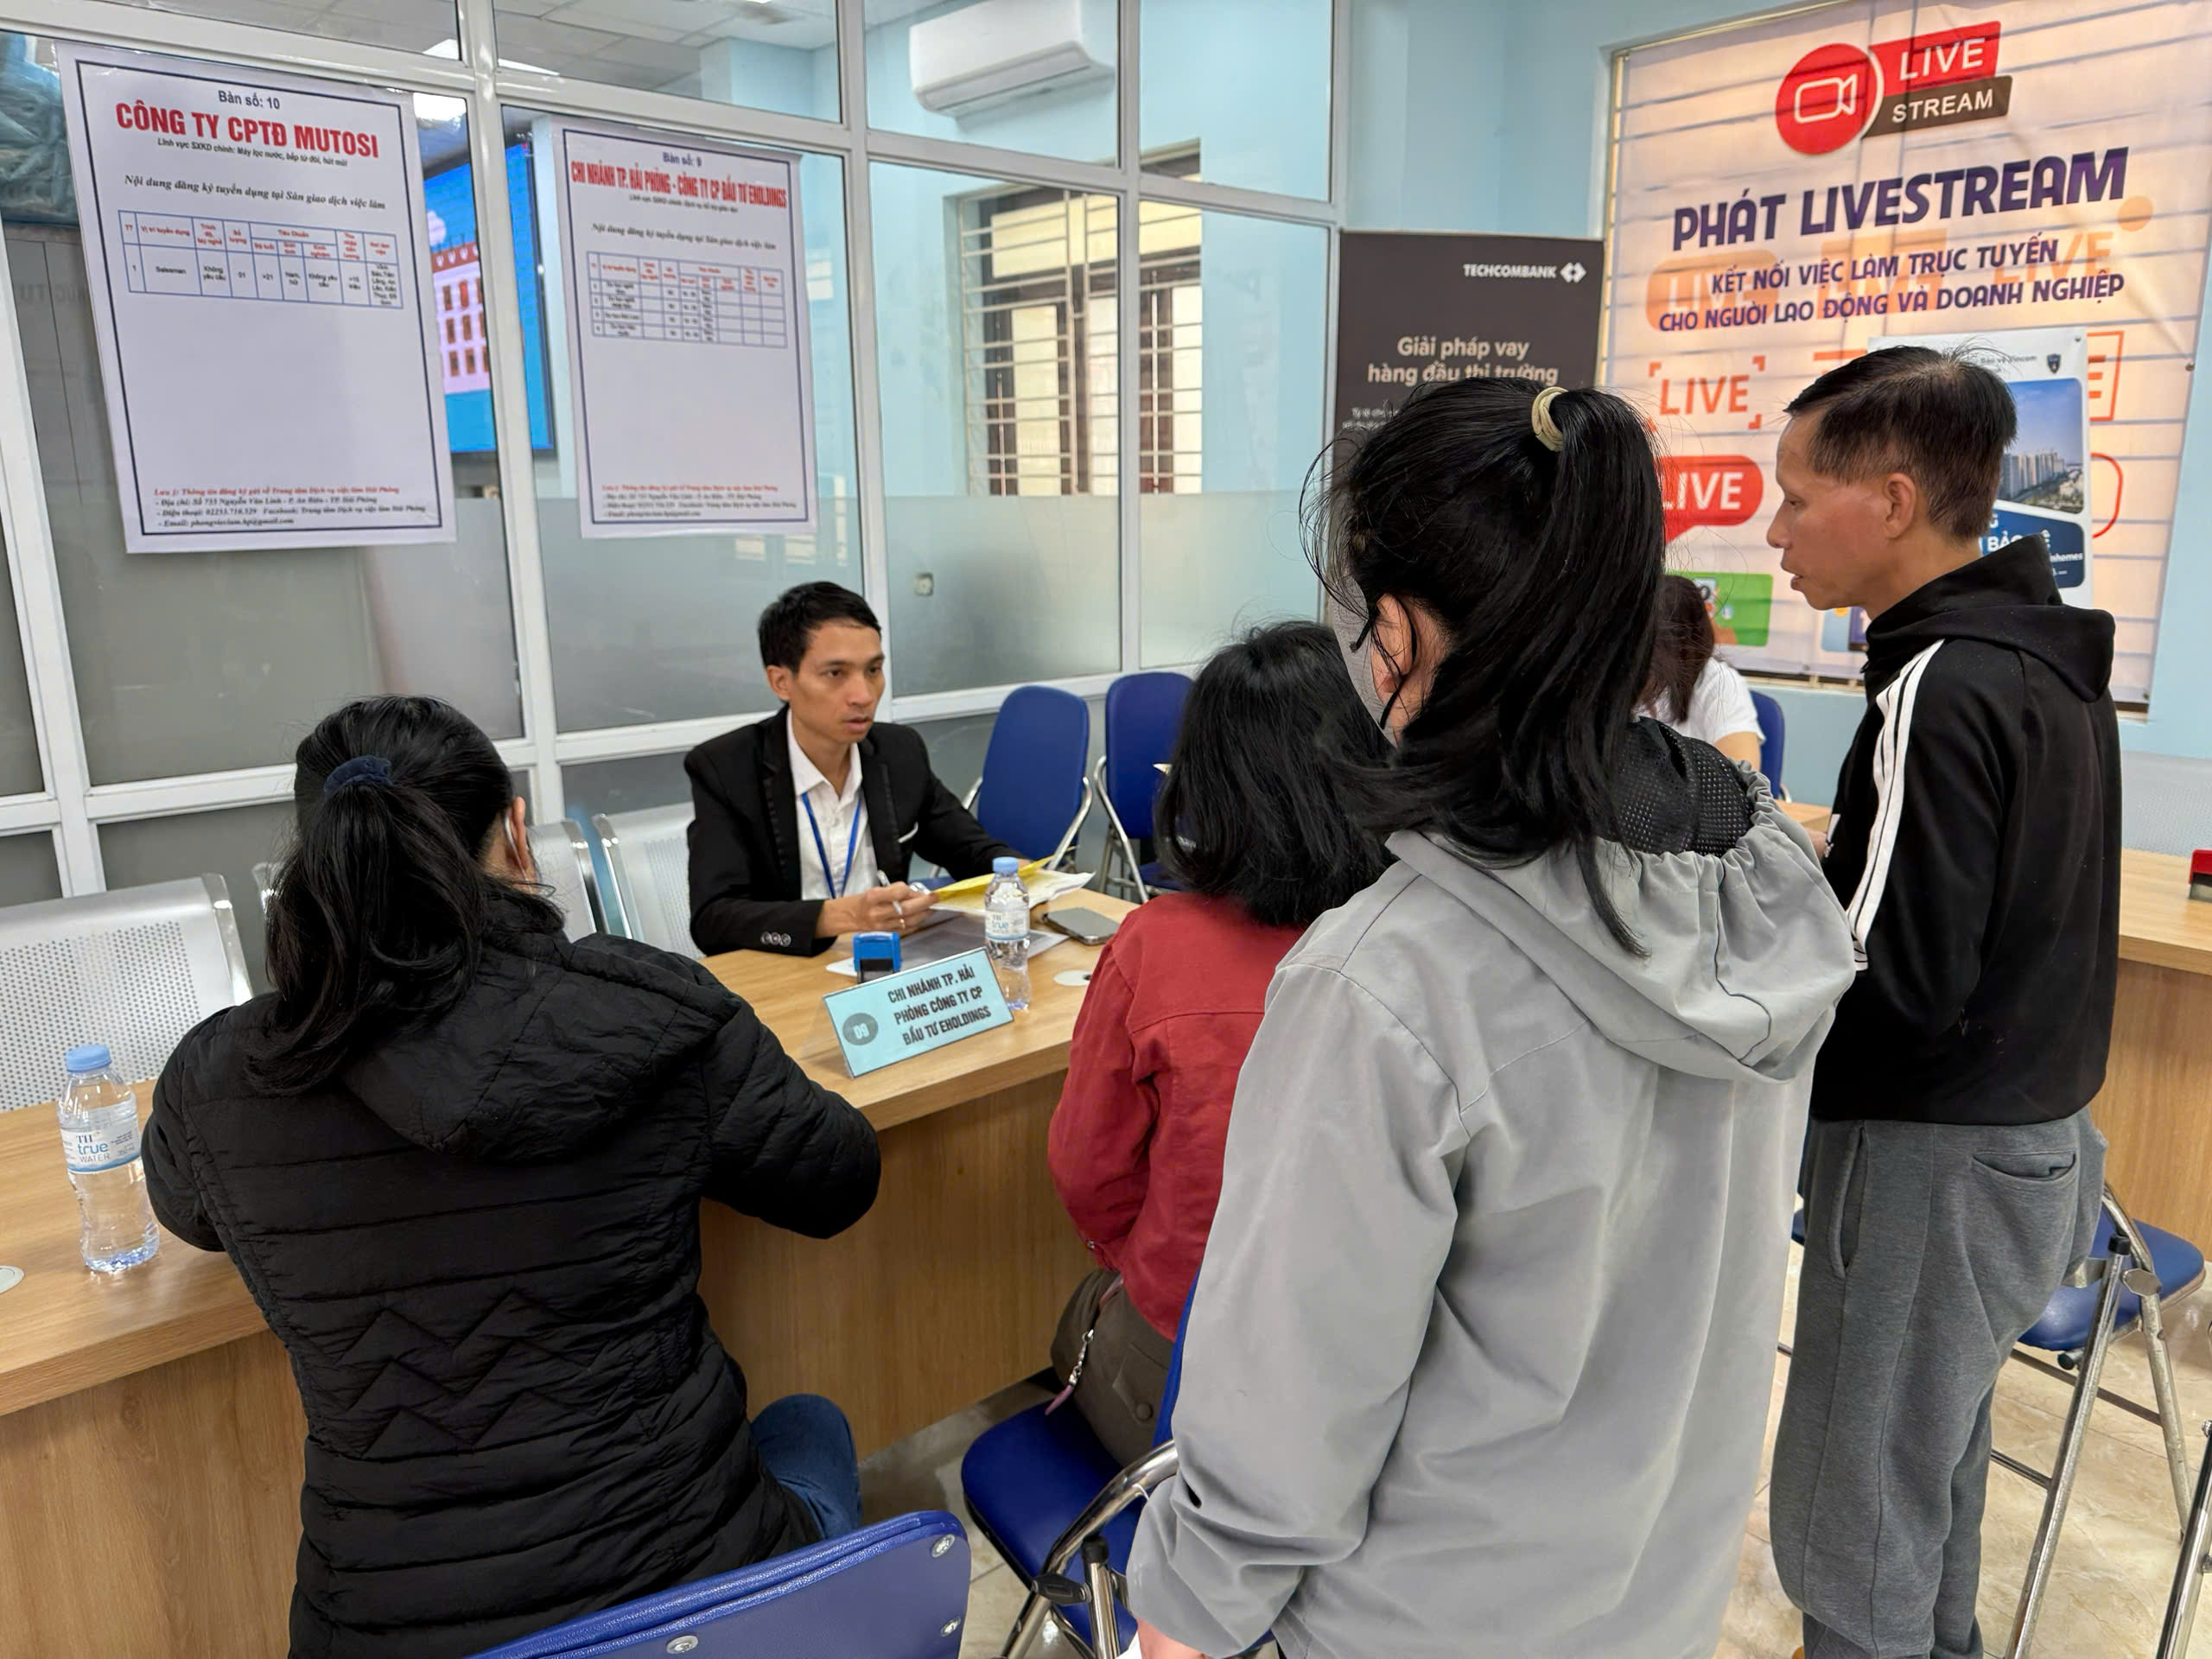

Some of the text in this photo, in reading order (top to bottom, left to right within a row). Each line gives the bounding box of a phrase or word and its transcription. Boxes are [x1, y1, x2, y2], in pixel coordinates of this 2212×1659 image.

[1899, 37, 1986, 80] LIVE
[218, 90, 280, 110] Bàn số: 10
[1891, 88, 1994, 124] STREAM
[116, 99, 379, 158] CÔNG TY CPTĐ MUTOSI
[192, 141, 212, 152] SXKD
[571, 160, 586, 183] CHI
[587, 159, 616, 188] NHÁNH
[124, 175, 143, 188] Nội
[146, 177, 172, 190] dung
[175, 180, 200, 193] đăng
[216, 183, 243, 195] tuyển
[245, 187, 269, 200] dụng
[271, 190, 283, 200] tại
[286, 190, 304, 201] Sàn
[306, 194, 326, 204] giao
[328, 195, 347, 207] dịch
[350, 197, 367, 209] việc
[369, 199, 385, 209] làm
[1673, 146, 2129, 251] PHÁT LIVESTREAM
[1463, 264, 1557, 278] TECHCOMBANK
[1712, 232, 2059, 294] KẾT NỐI VIỆC LÀM TRỰC TUYẾN
[1659, 312, 1699, 331] CHO
[1774, 301, 1814, 323] LAO
[1823, 291, 1889, 323] ĐỘNG
[1897, 284, 1928, 313] VÀ
[1936, 282, 2024, 310] DOANH
[2031, 270, 2125, 304] NGHIỆP
[1396, 335, 1530, 361] Giải pháp vay
[1368, 363, 1418, 386] hàng
[1659, 375, 1750, 415] LIVE
[887, 963, 976, 1003] CHI NHÁNH TP. HẢI
[893, 986, 983, 1026] PHÒNG CÔNG TY CP
[938, 1005, 992, 1033] EHOLDINGS
[76, 1135, 93, 1144] TH
[78, 1142, 109, 1155] true
[79, 1153, 110, 1163] WATER
